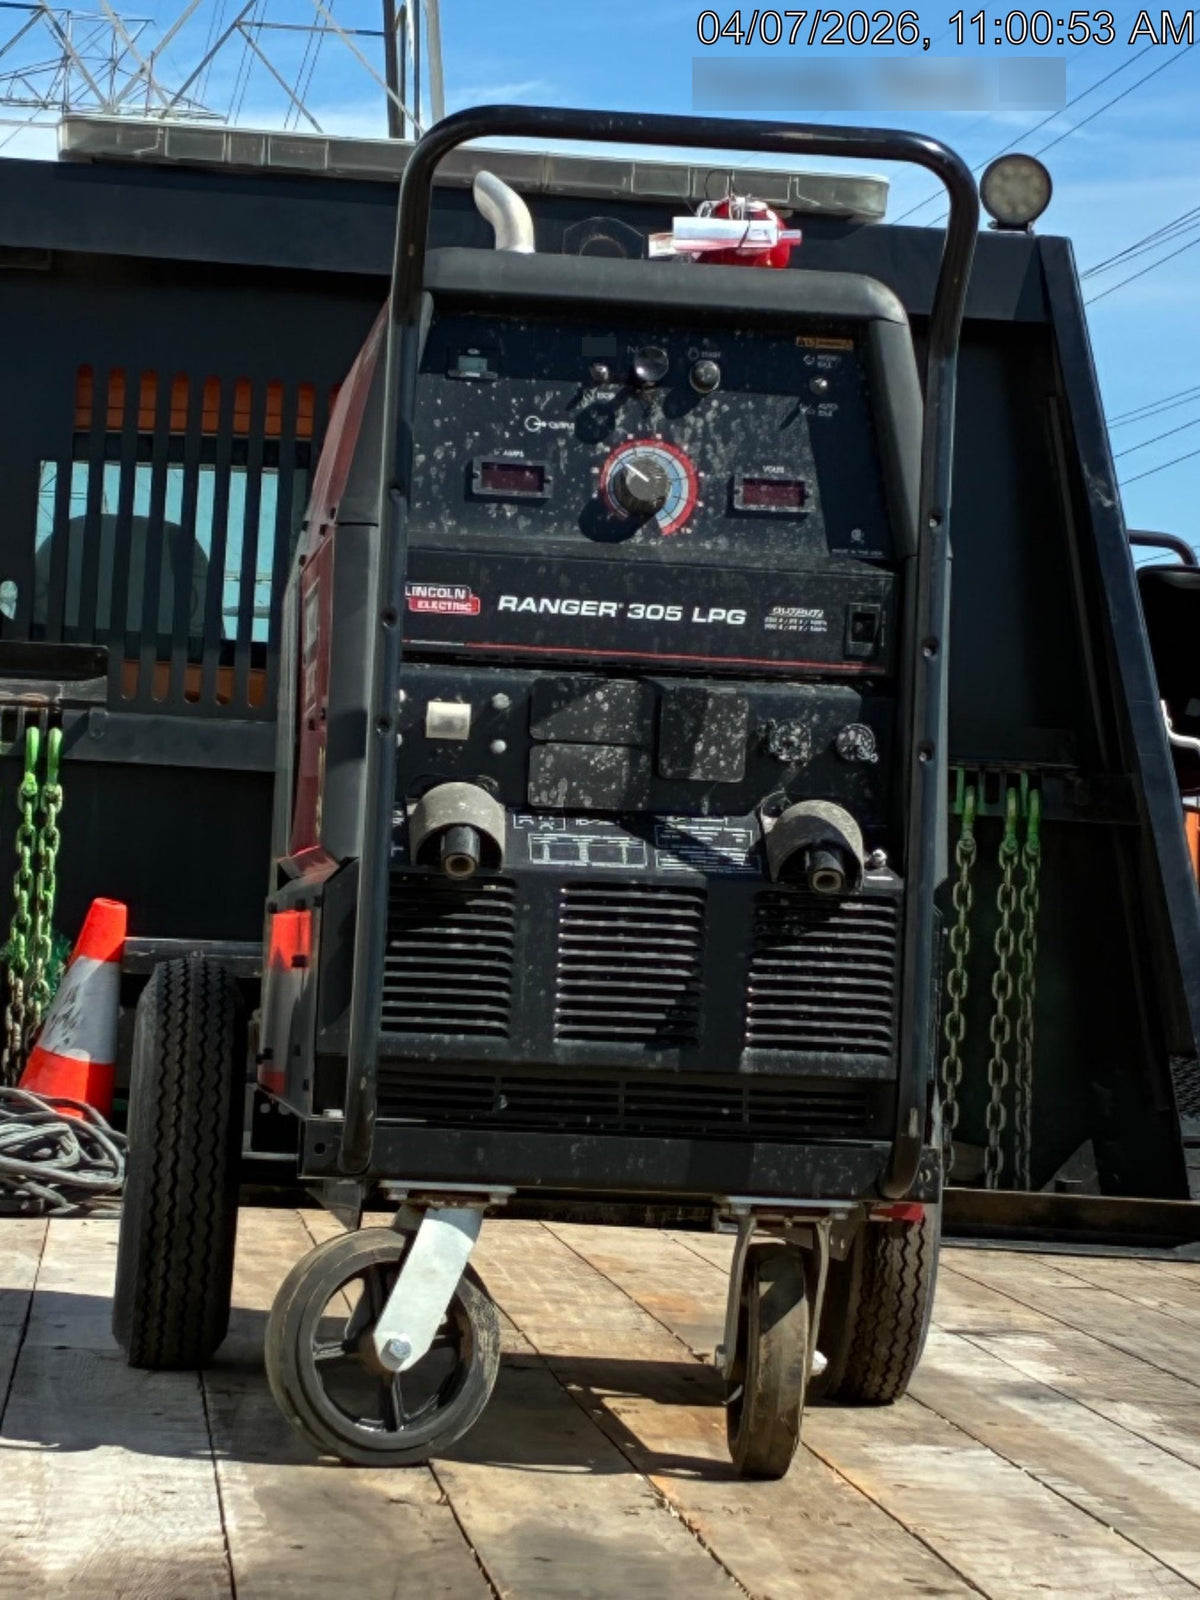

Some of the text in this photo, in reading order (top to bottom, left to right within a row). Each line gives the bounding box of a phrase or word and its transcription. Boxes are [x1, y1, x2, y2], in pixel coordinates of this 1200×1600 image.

[404, 585, 467, 600] LINCOLN
[416, 600, 472, 612] ELECTRIC
[627, 603, 683, 621] 305
[692, 607, 747, 625] LPG
